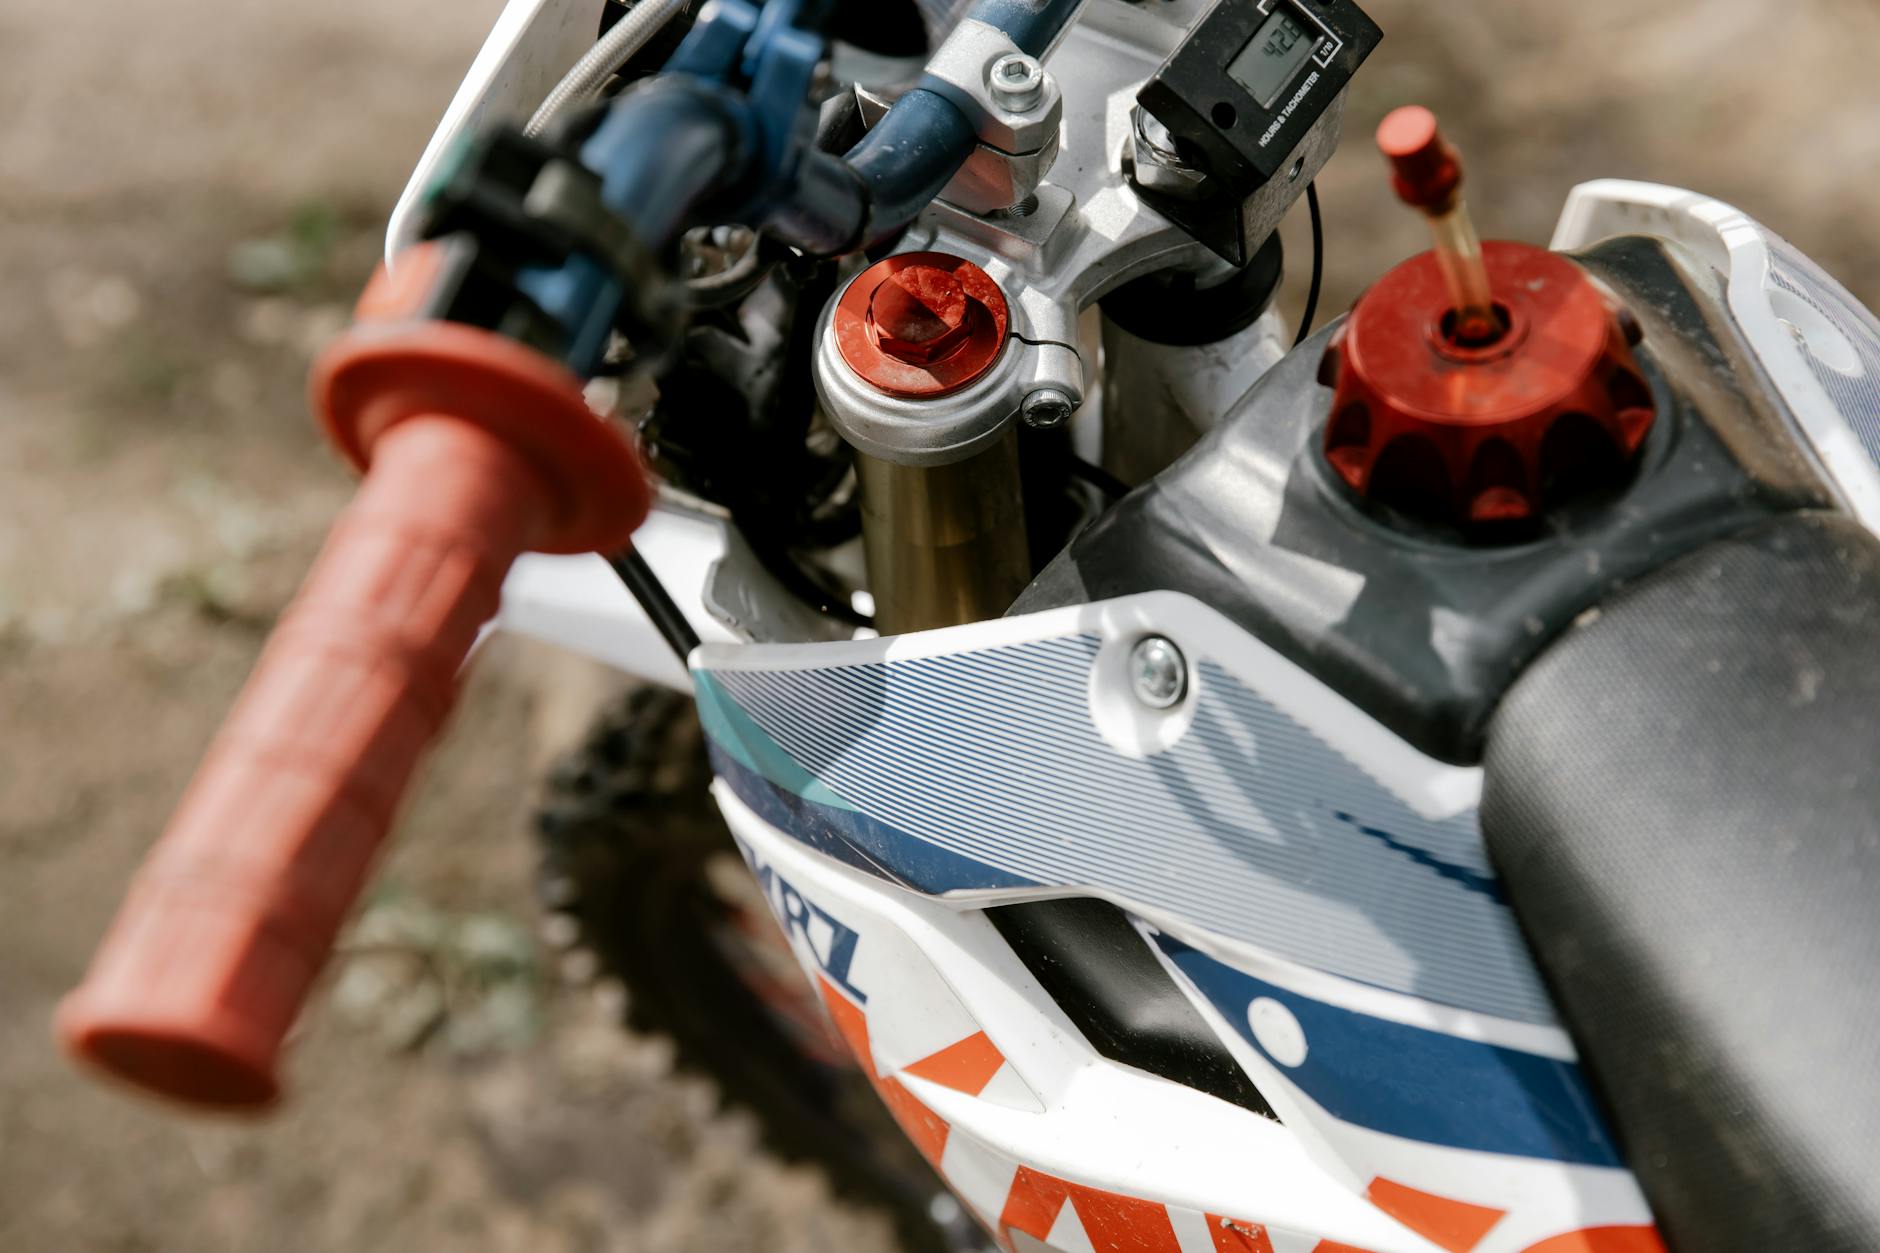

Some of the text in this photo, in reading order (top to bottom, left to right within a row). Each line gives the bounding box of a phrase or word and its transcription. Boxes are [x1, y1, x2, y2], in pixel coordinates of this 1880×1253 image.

[1320, 42, 1333, 56] 1/10
[1258, 120, 1281, 147] HOURS
[1281, 71, 1319, 117] TACHOMETER
